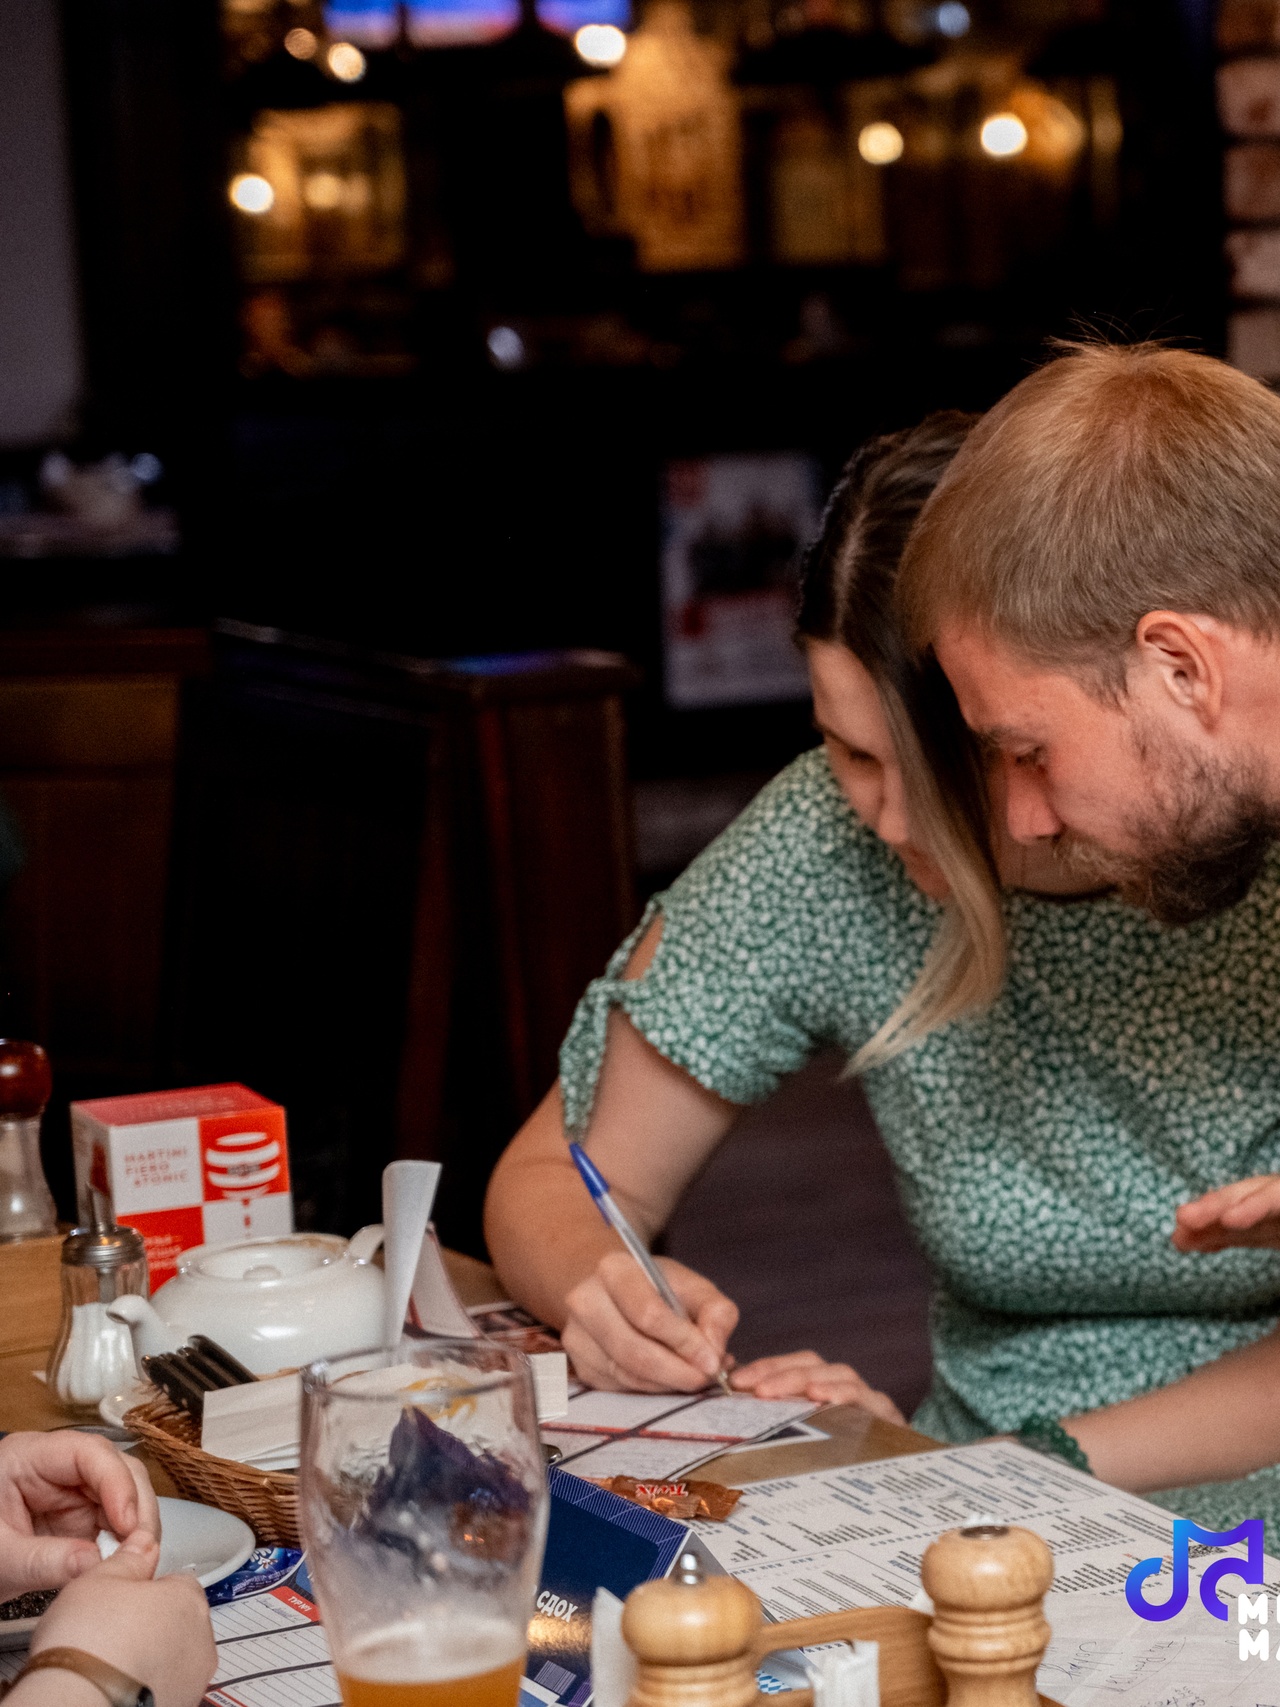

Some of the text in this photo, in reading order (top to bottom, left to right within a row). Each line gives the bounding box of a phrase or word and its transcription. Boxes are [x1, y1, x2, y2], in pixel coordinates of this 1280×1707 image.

[125, 1147, 188, 1162] MARTINI
[126, 1162, 170, 1175] FIERO
[536, 1590, 578, 1622] СДОХ
